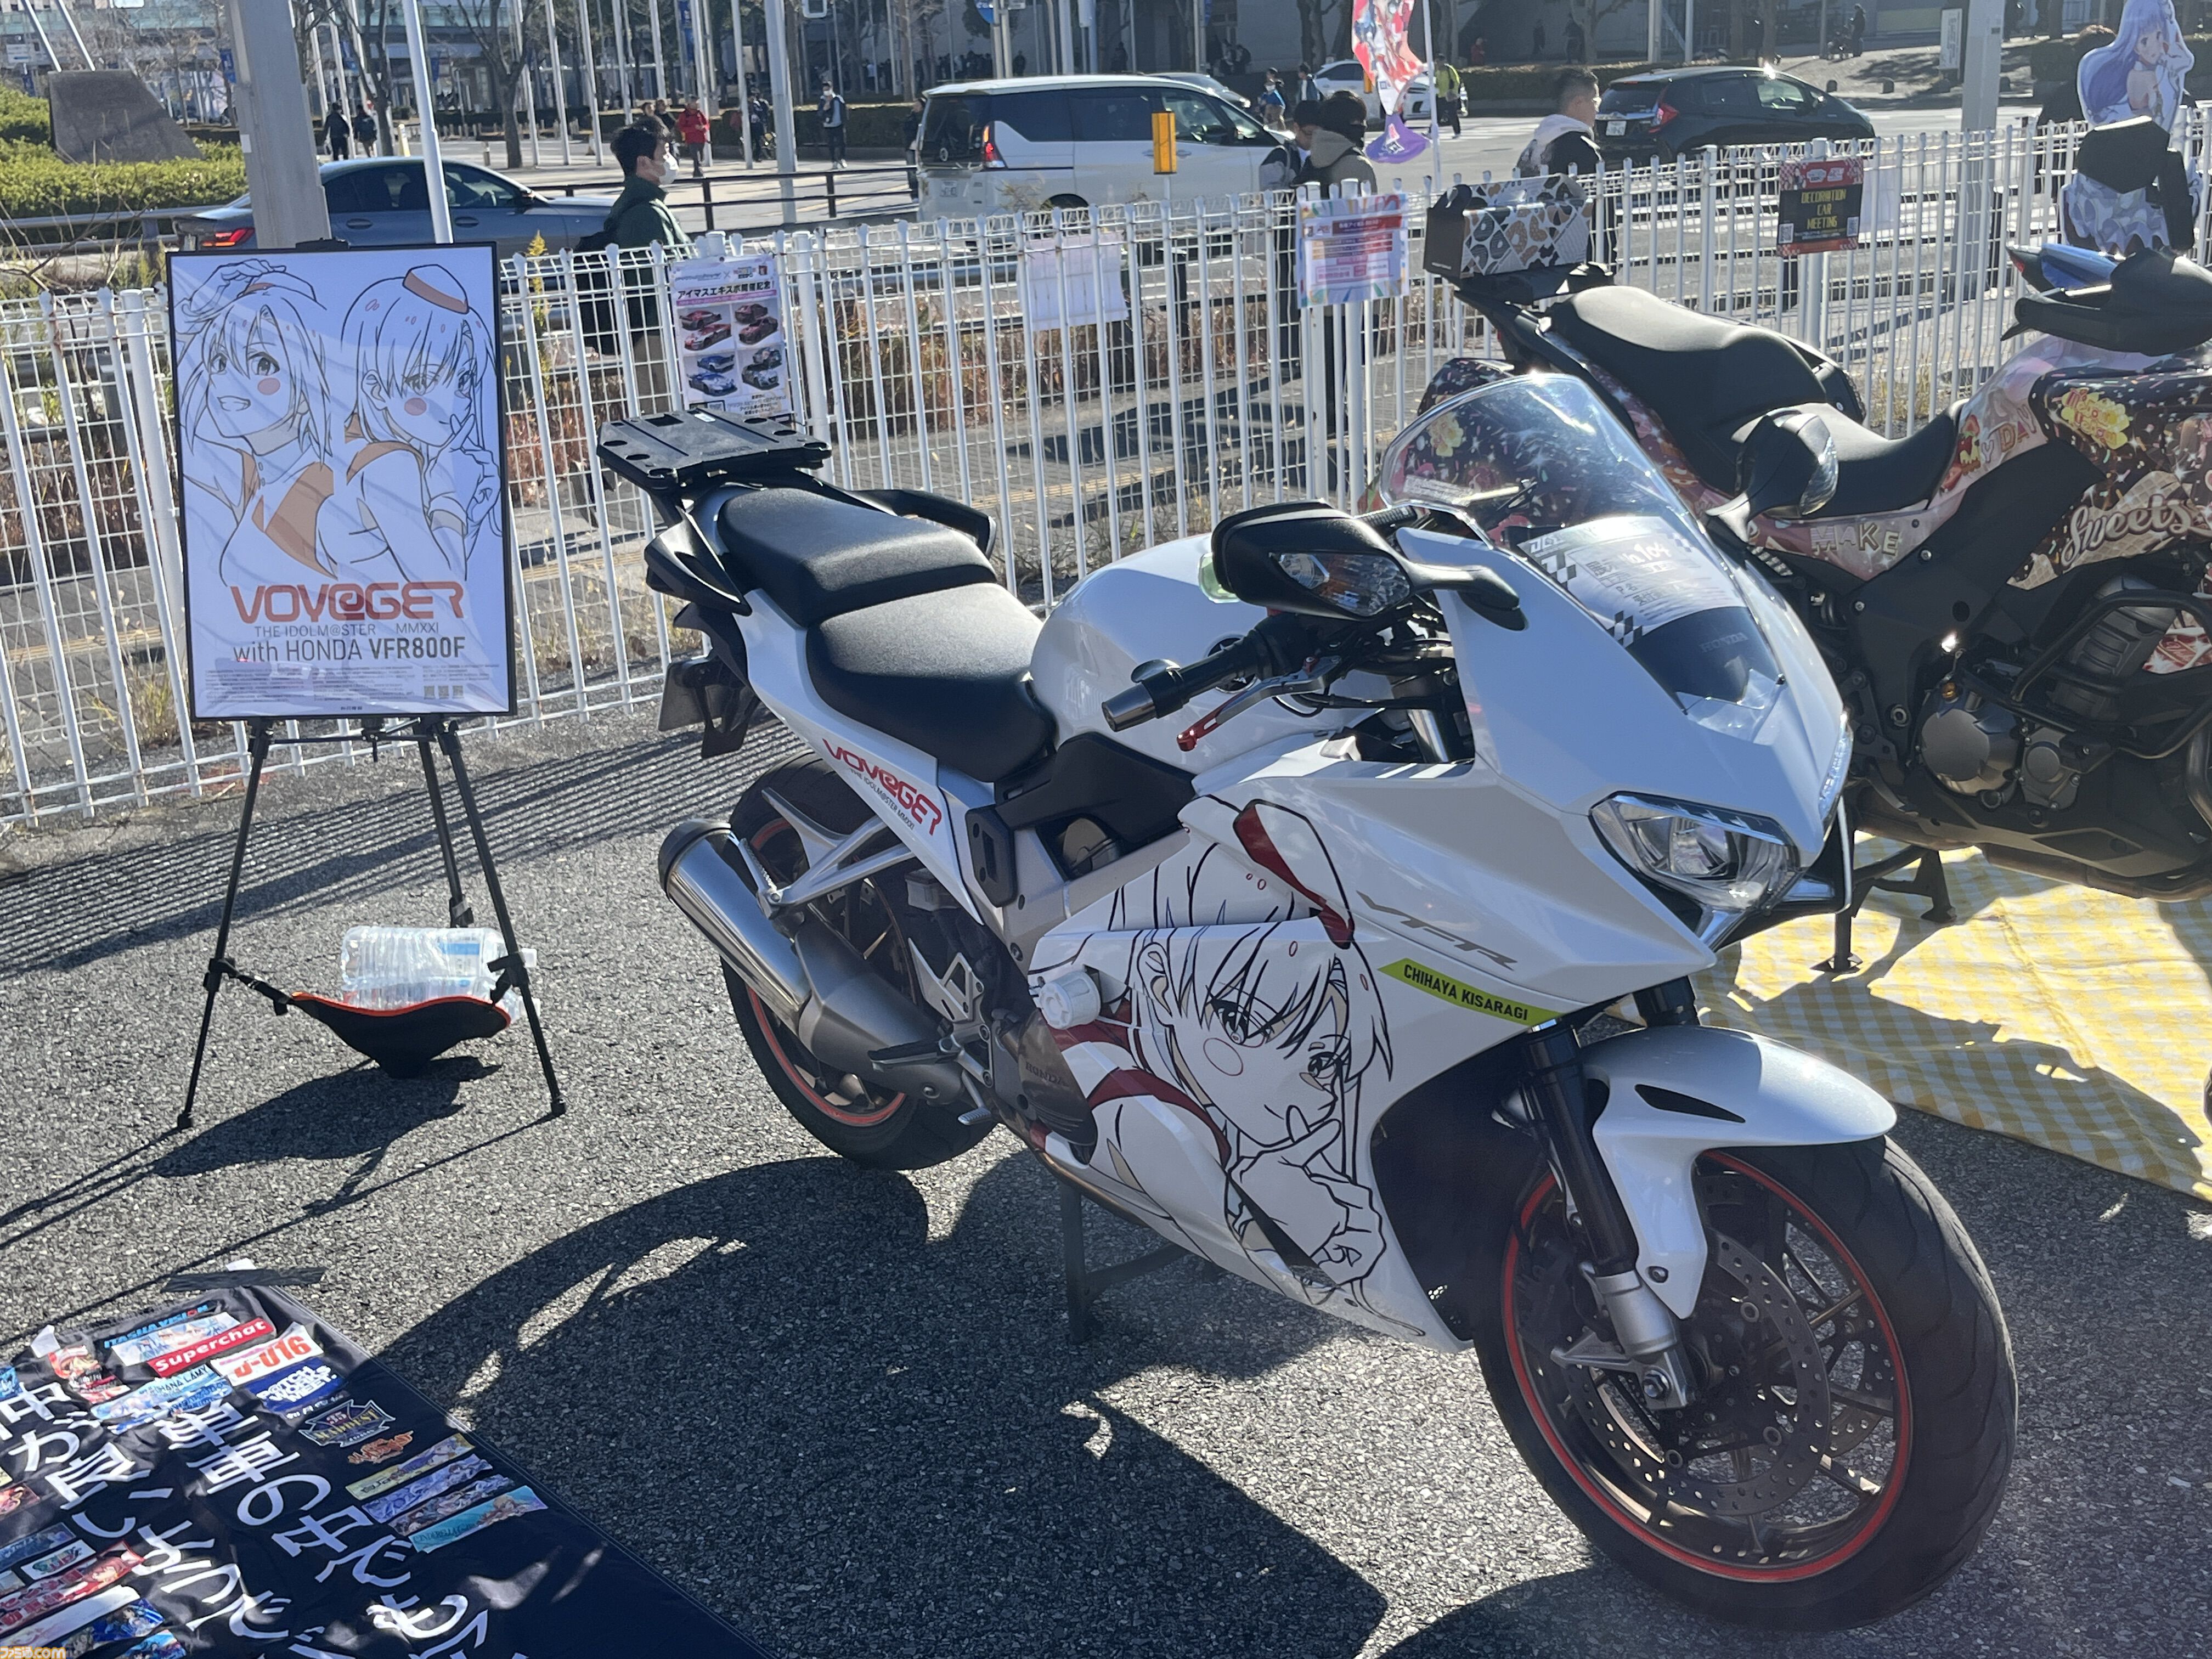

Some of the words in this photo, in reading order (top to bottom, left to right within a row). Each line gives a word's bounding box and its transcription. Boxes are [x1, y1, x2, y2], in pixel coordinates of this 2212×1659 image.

[1807, 216, 1837, 229] MEETING
[1817, 204, 1832, 215] CAR
[1810, 523, 1900, 557] MAKE
[2061, 494, 2193, 567] Sweets
[254, 625, 282, 637] THE
[284, 623, 376, 636] IDOLM@STER
[396, 622, 439, 634] MMXXI
[1699, 631, 1748, 652] HONDA
[233, 641, 279, 663] with
[286, 639, 362, 661] HONDA
[369, 635, 466, 659] VFR800F
[850, 769, 863, 780] THE
[864, 775, 898, 815] IDOLM@STER
[897, 809, 916, 831] MMXXI
[1403, 964, 1457, 1000] CHIHAYA
[1461, 989, 1528, 1021] KISARAGI
[1025, 1061, 1069, 1087] HONDA
[155, 1320, 267, 1373] Superchat
[183, 1365, 208, 1383] LAMY
[269, 1365, 331, 1401] WORKS
